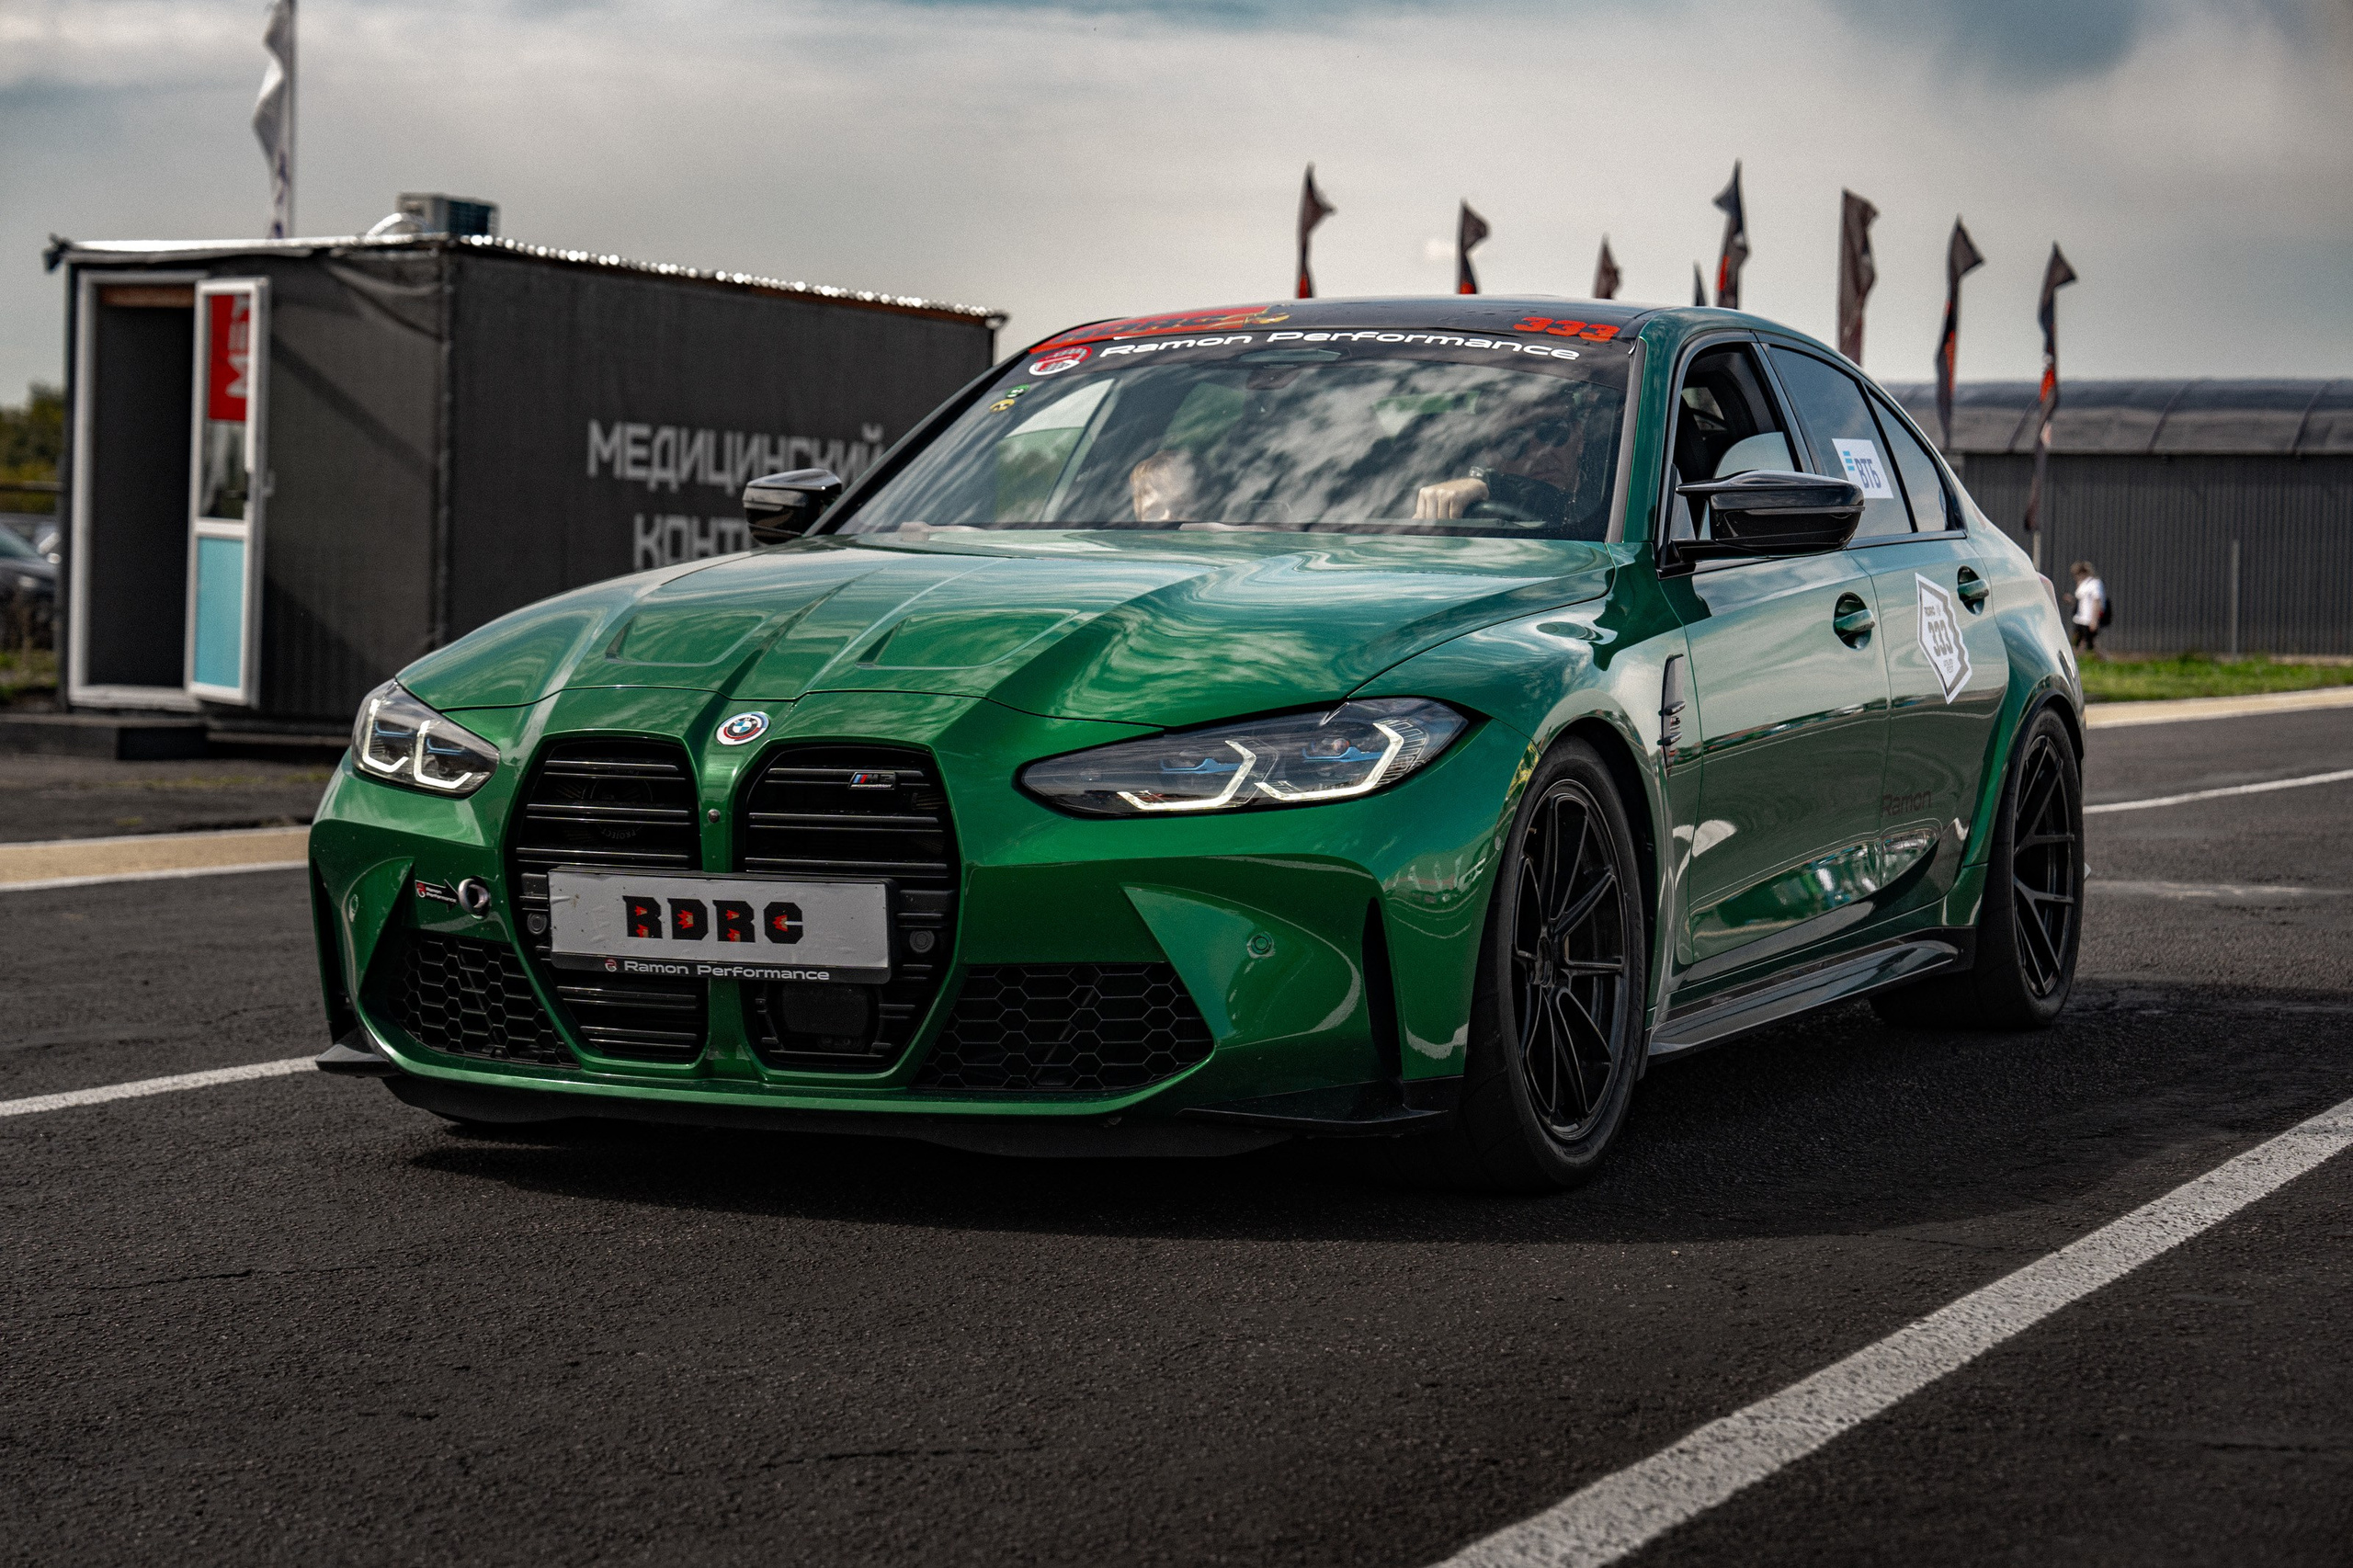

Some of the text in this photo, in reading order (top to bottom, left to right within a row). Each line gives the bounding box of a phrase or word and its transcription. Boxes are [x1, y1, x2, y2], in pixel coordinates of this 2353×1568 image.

[1513, 316, 1621, 343] 333
[1099, 331, 1581, 360] Ramon Performance
[1854, 458, 1881, 489] ВТБ
[1927, 619, 1954, 656] 333
[1882, 790, 1931, 816] Ramon
[600, 828, 637, 840] PROJECT
[622, 895, 804, 944] RDRC
[624, 960, 830, 981] Ramon Performance
